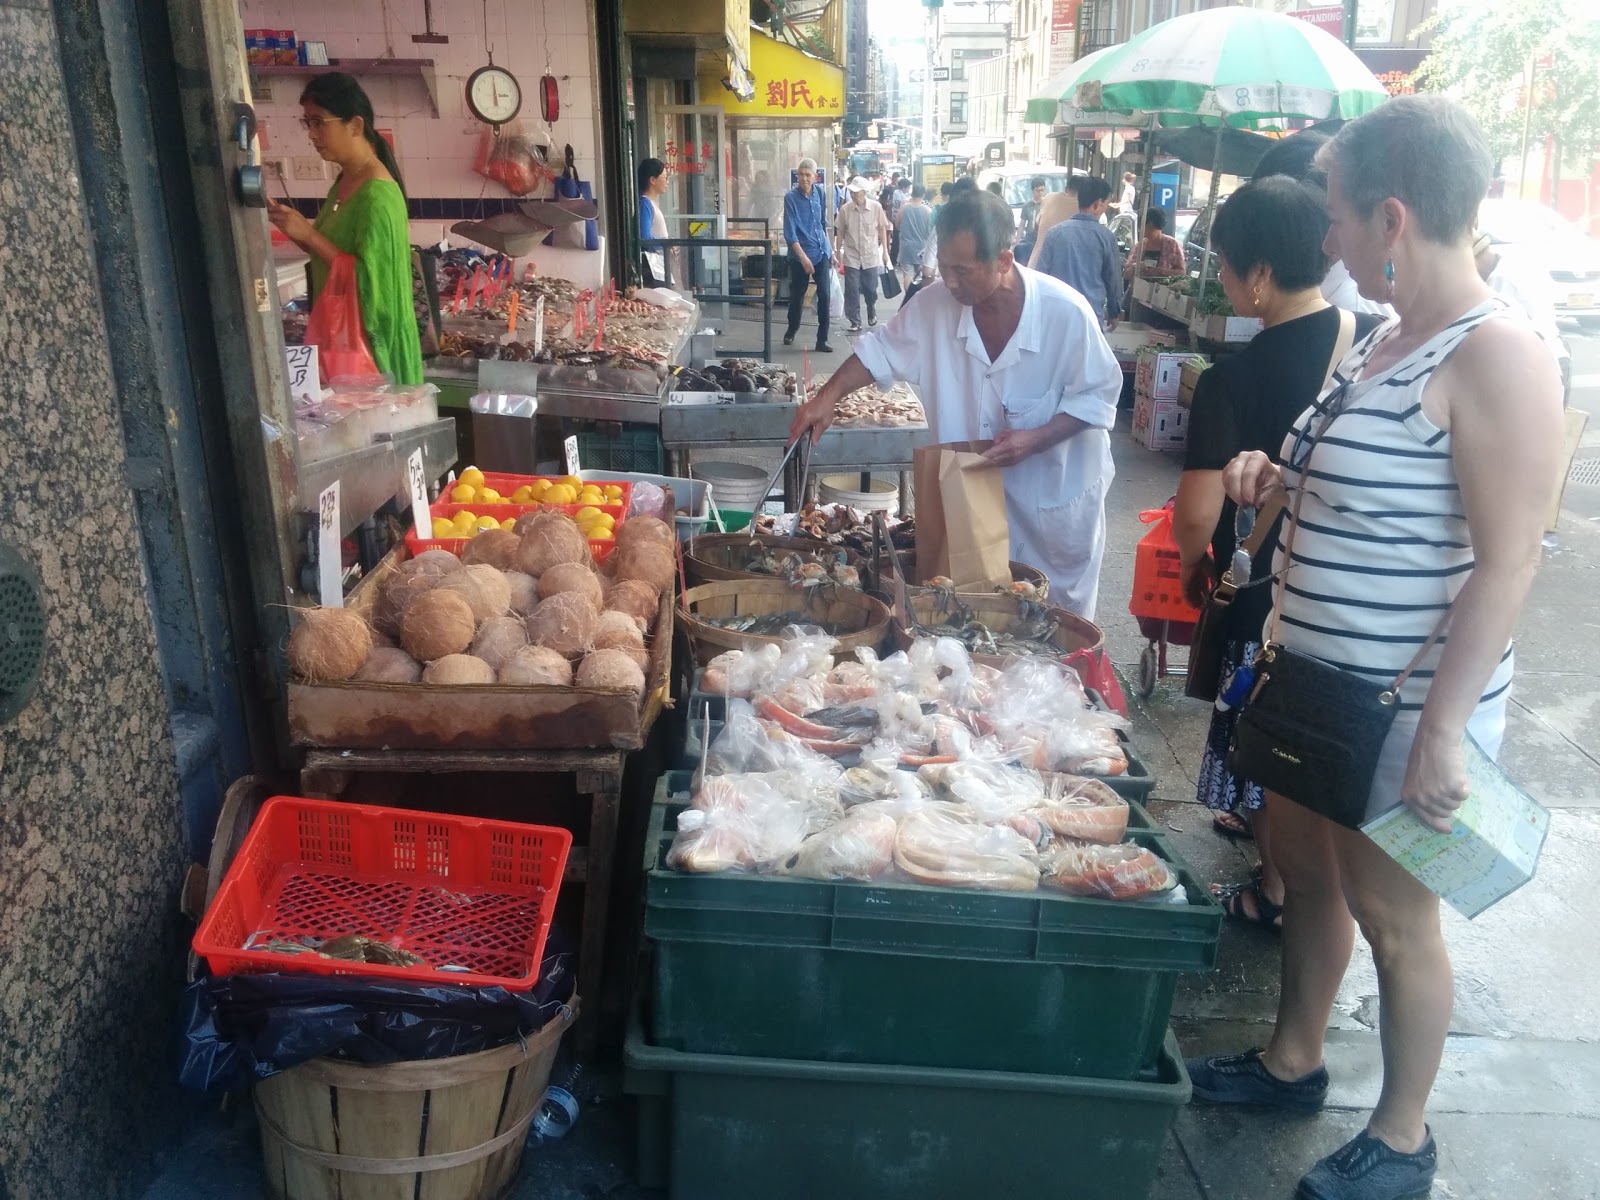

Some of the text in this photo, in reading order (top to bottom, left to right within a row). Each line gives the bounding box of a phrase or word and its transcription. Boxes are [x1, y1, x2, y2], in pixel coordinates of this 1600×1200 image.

[1302, 12, 1342, 23] STANDING
[1052, 33, 1058, 44] 3
[665, 162, 707, 173] PHARMACY
[1161, 187, 1173, 206] P
